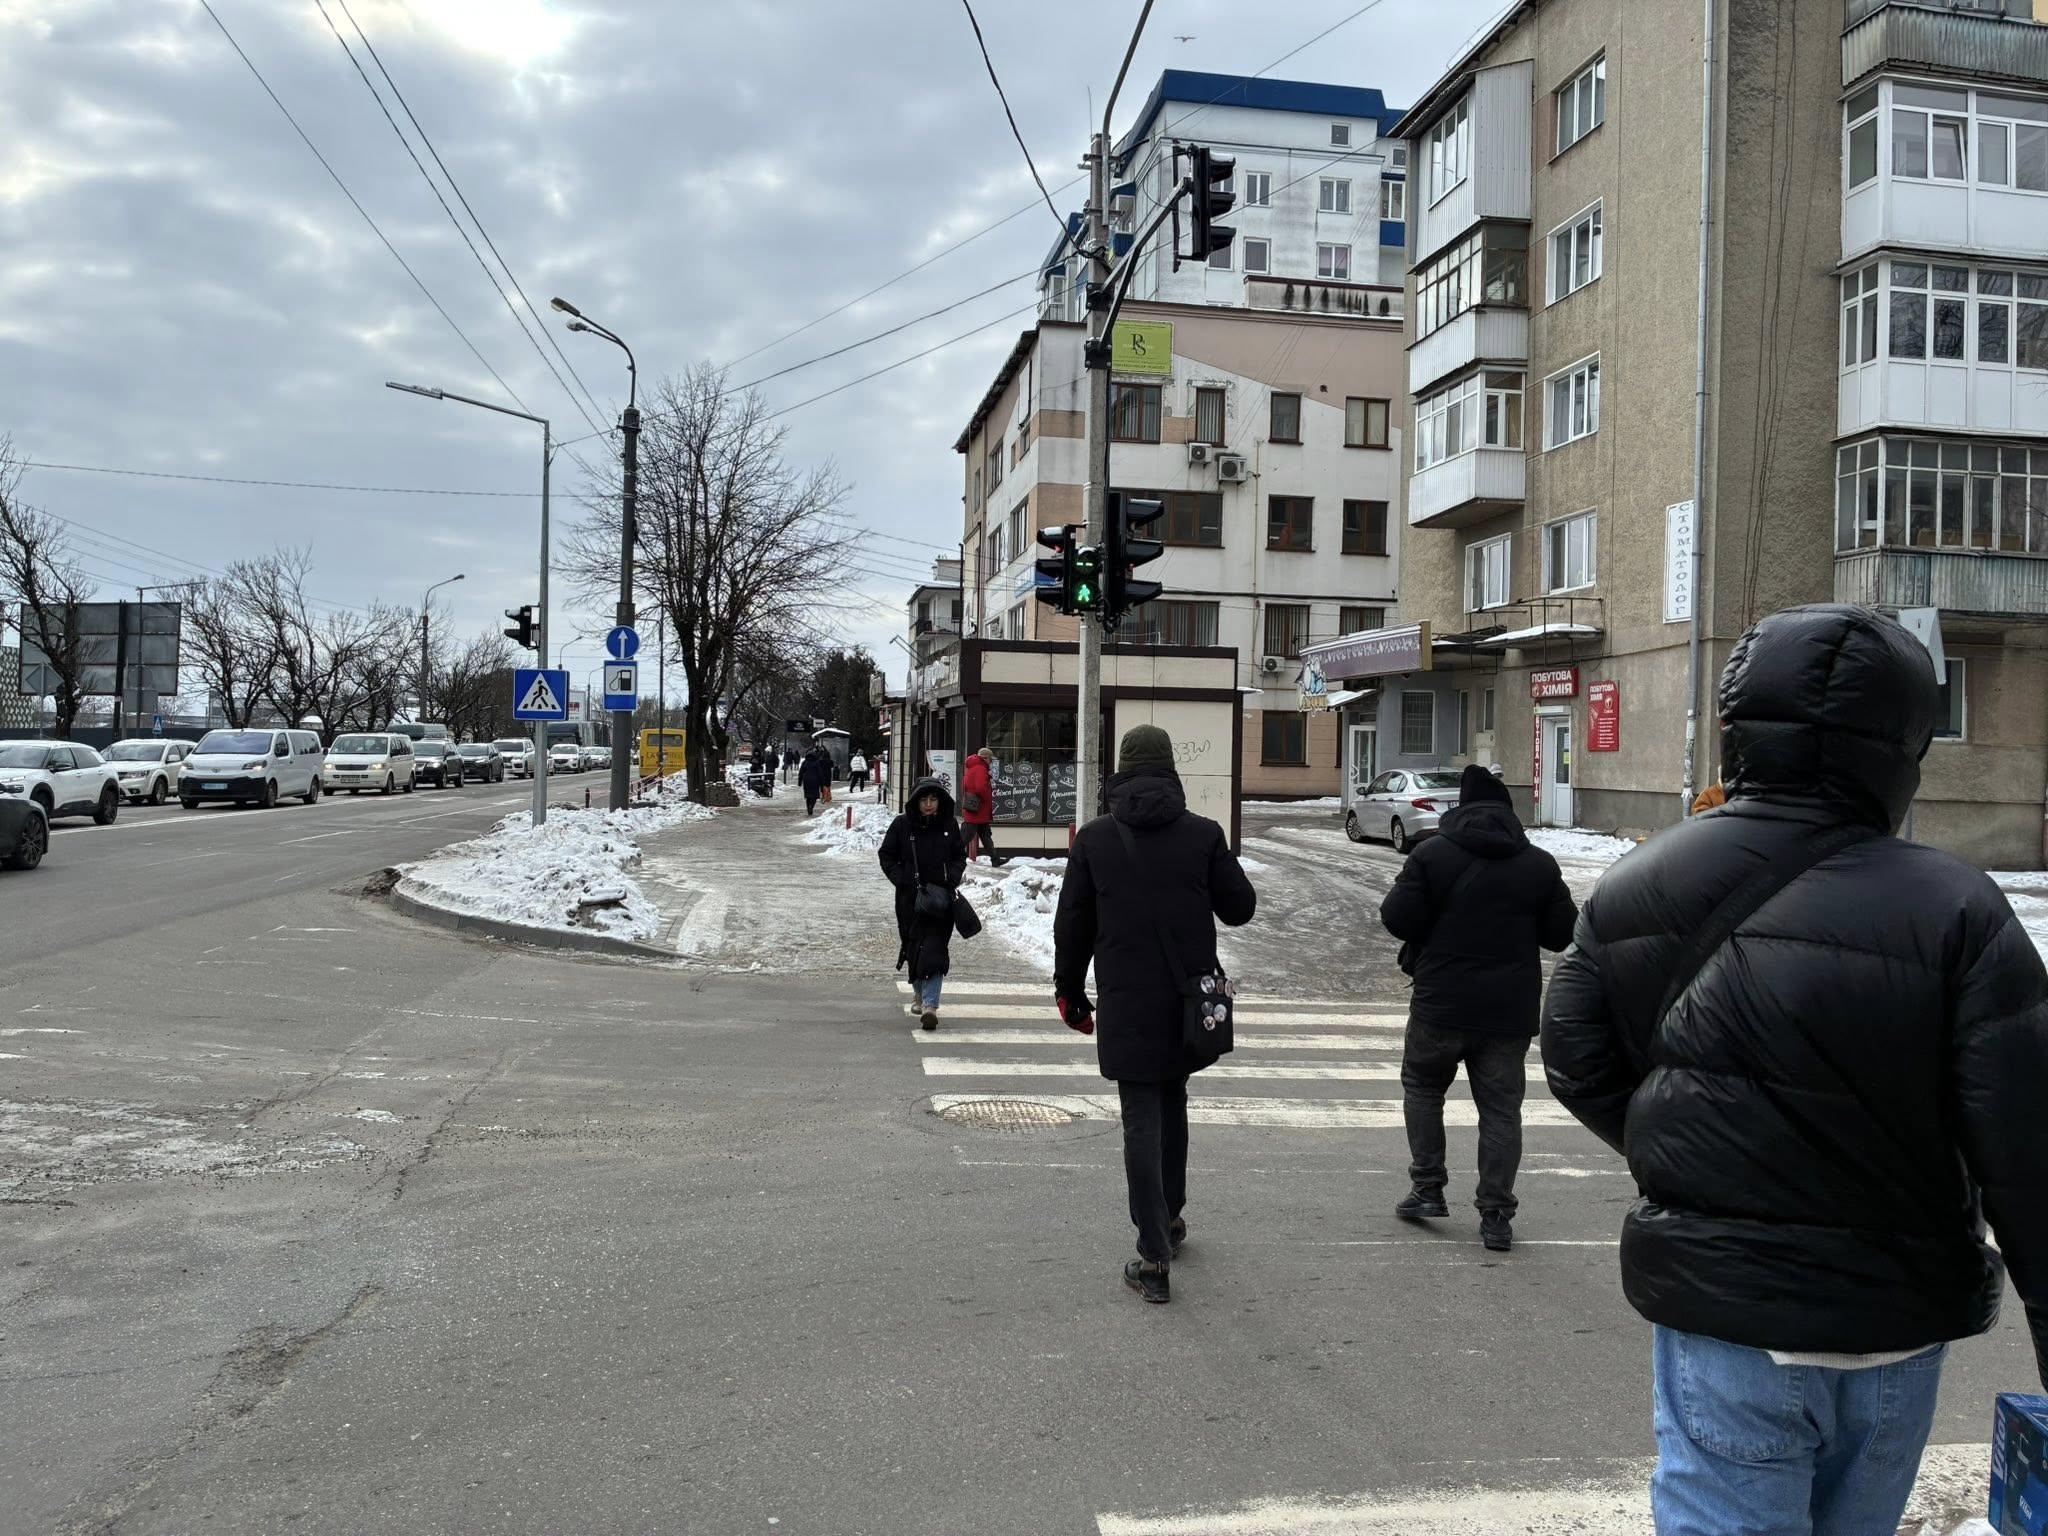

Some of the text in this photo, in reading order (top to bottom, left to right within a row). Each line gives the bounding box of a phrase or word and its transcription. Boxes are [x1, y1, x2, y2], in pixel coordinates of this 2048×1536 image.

[1675, 503, 1691, 615] СТОМАТОЛОГ
[1531, 669, 1572, 683] ПОБУТОВА
[1542, 682, 1573, 696] ХІМІЯ
